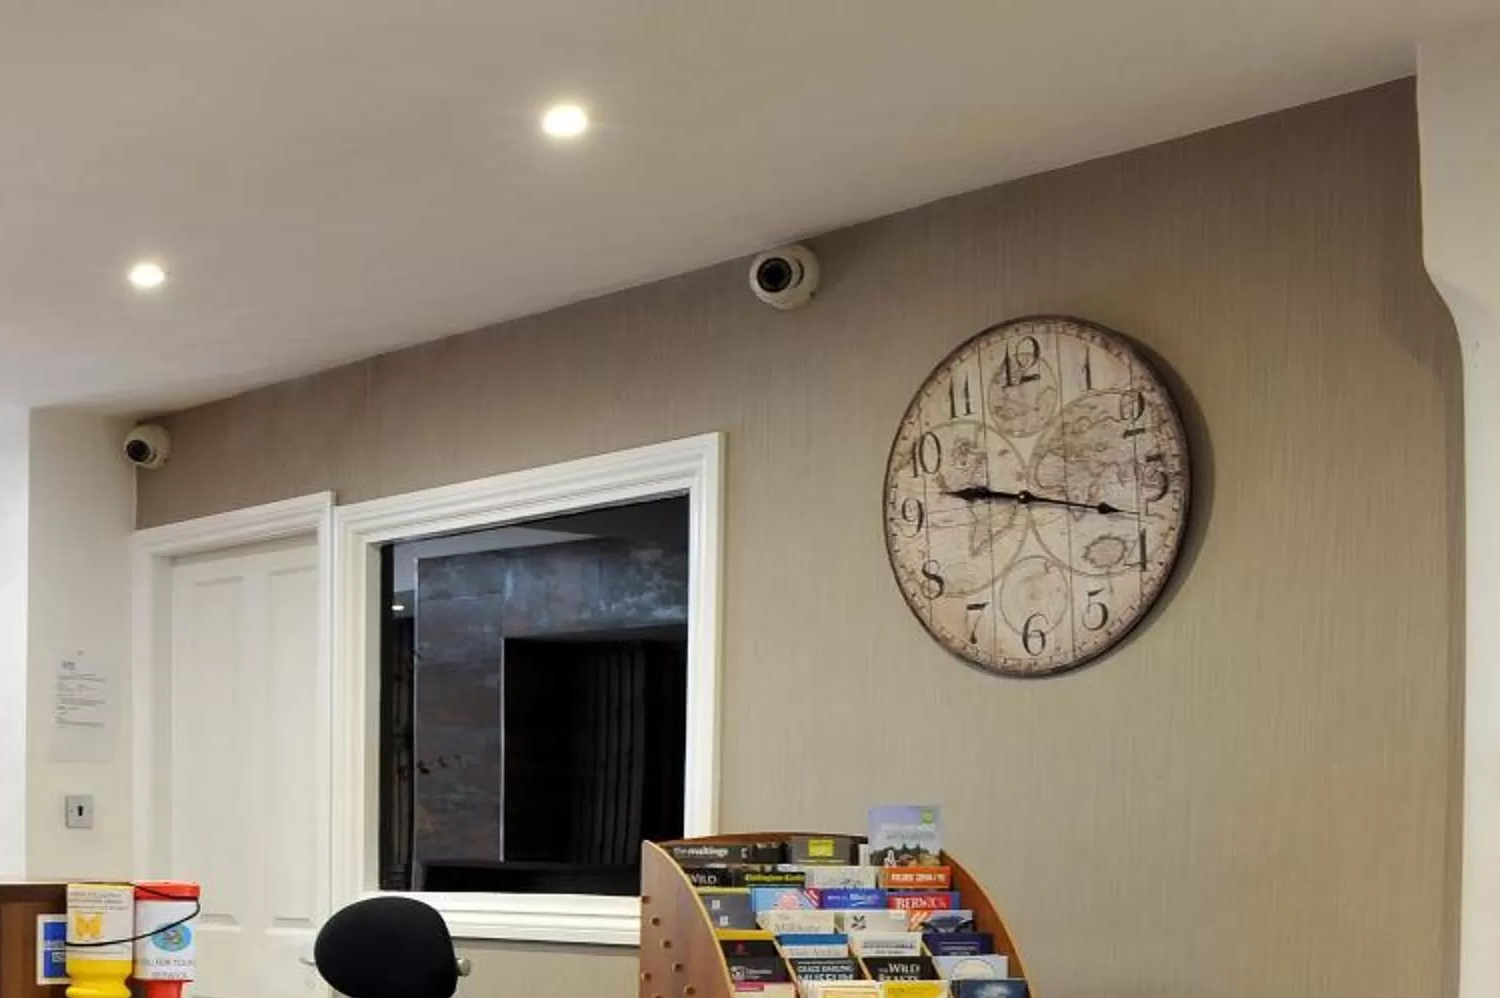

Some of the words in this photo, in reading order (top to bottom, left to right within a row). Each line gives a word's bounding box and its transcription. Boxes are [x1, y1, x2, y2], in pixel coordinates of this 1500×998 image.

[1002, 335, 1041, 387] 12
[1083, 346, 1093, 390] 1
[949, 375, 973, 419] 11
[1119, 391, 1146, 439] 2
[909, 431, 942, 478] 10
[1144, 453, 1170, 502] 3
[901, 496, 925, 538] 9
[1122, 528, 1148, 572] 4
[920, 559, 945, 600] 8
[966, 602, 991, 645] 7
[1082, 588, 1109, 631] 5
[1021, 612, 1047, 656] 6
[887, 962, 921, 974] WILD
